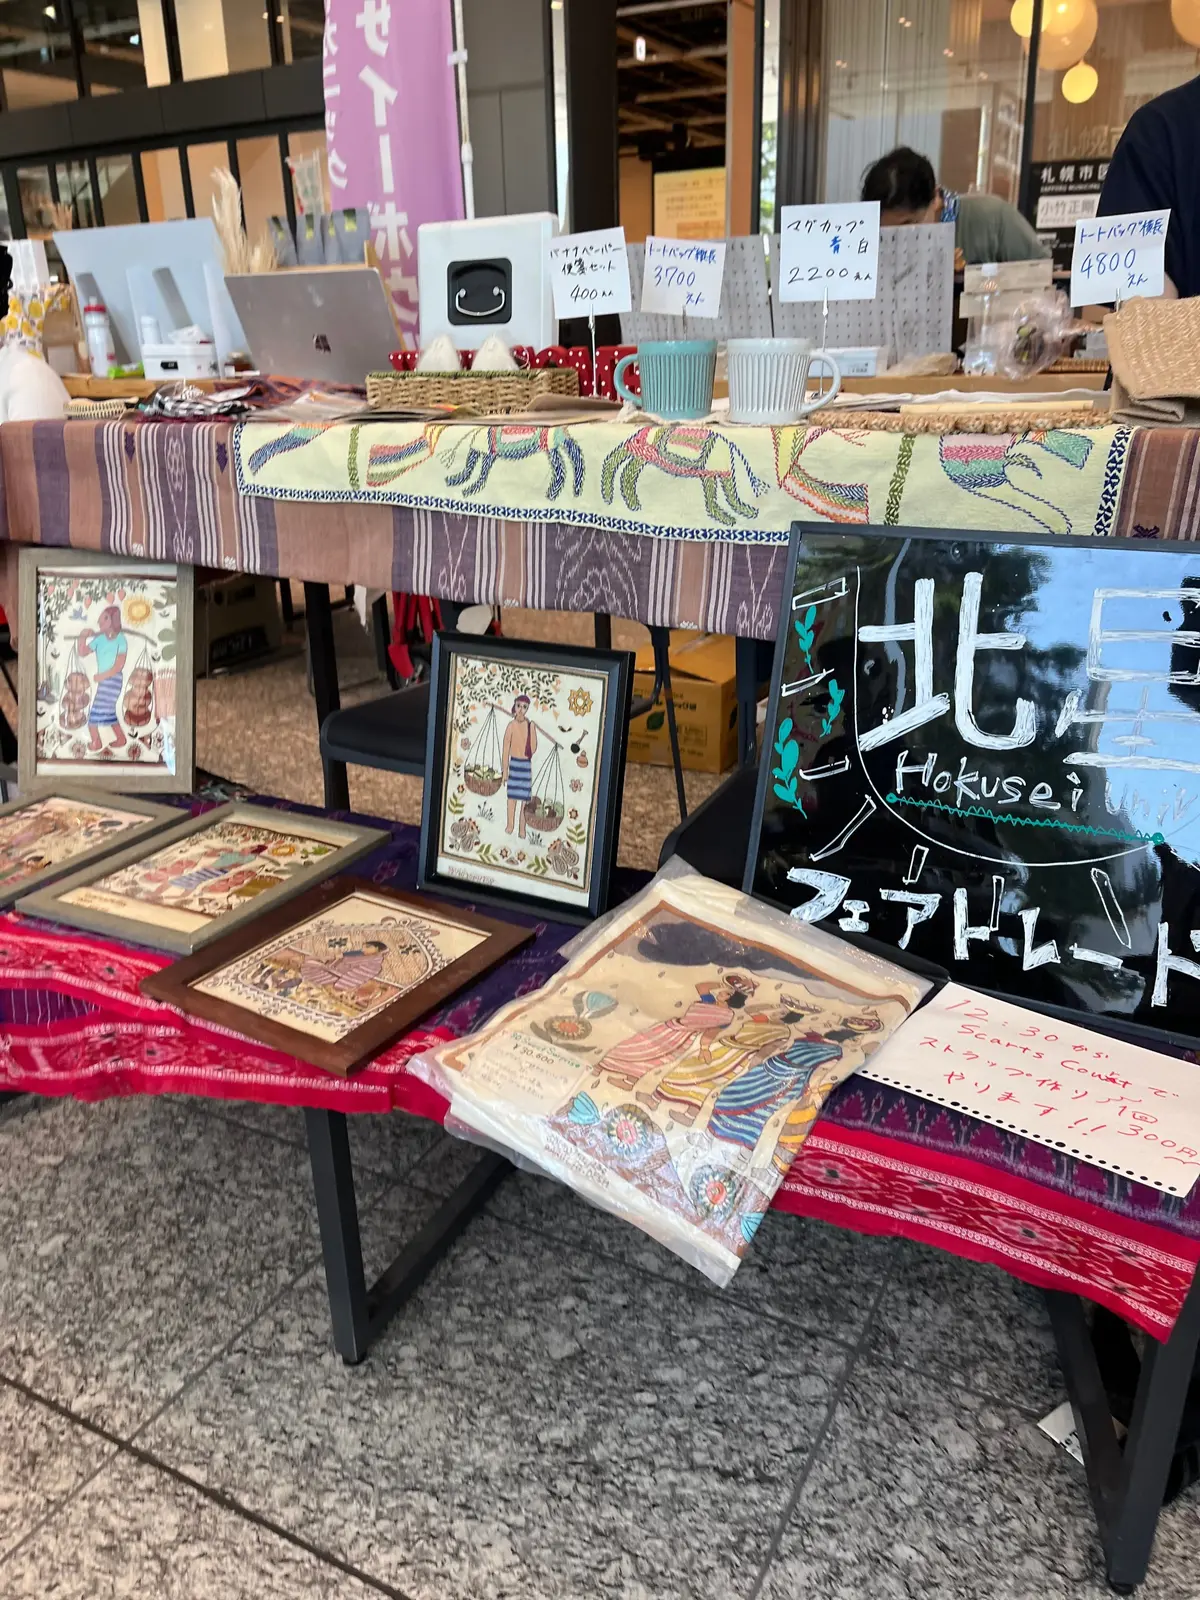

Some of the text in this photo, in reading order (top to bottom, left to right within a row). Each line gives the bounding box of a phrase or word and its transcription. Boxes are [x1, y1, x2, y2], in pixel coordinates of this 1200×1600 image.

[787, 219, 865, 234] マグカップ
[1080, 217, 1164, 245] トートバッグ横長
[654, 265, 696, 287] 3700
[1080, 248, 1137, 279] 4800
[1128, 273, 1149, 289] えん
[685, 291, 705, 305] えん
[895, 750, 1084, 813] Hokusei
[786, 866, 1200, 1008] フェアトレード
[1116, 1123, 1199, 1160] 300円
